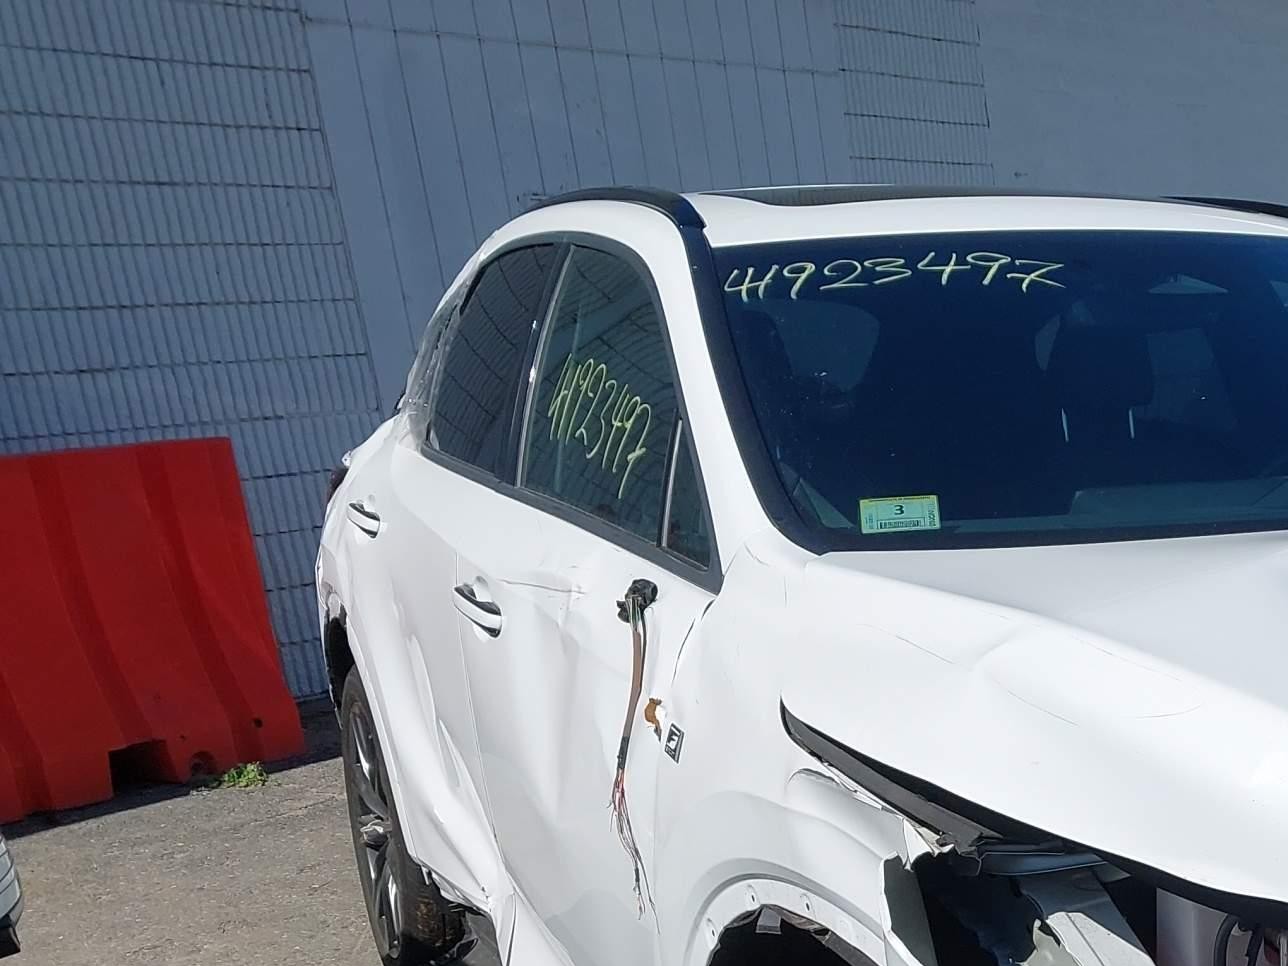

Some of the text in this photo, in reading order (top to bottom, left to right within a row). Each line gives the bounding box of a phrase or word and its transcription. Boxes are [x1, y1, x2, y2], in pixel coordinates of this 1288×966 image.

[724, 251, 1066, 302] 41923497
[548, 352, 651, 499] 41923497
[893, 504, 905, 516] 3
